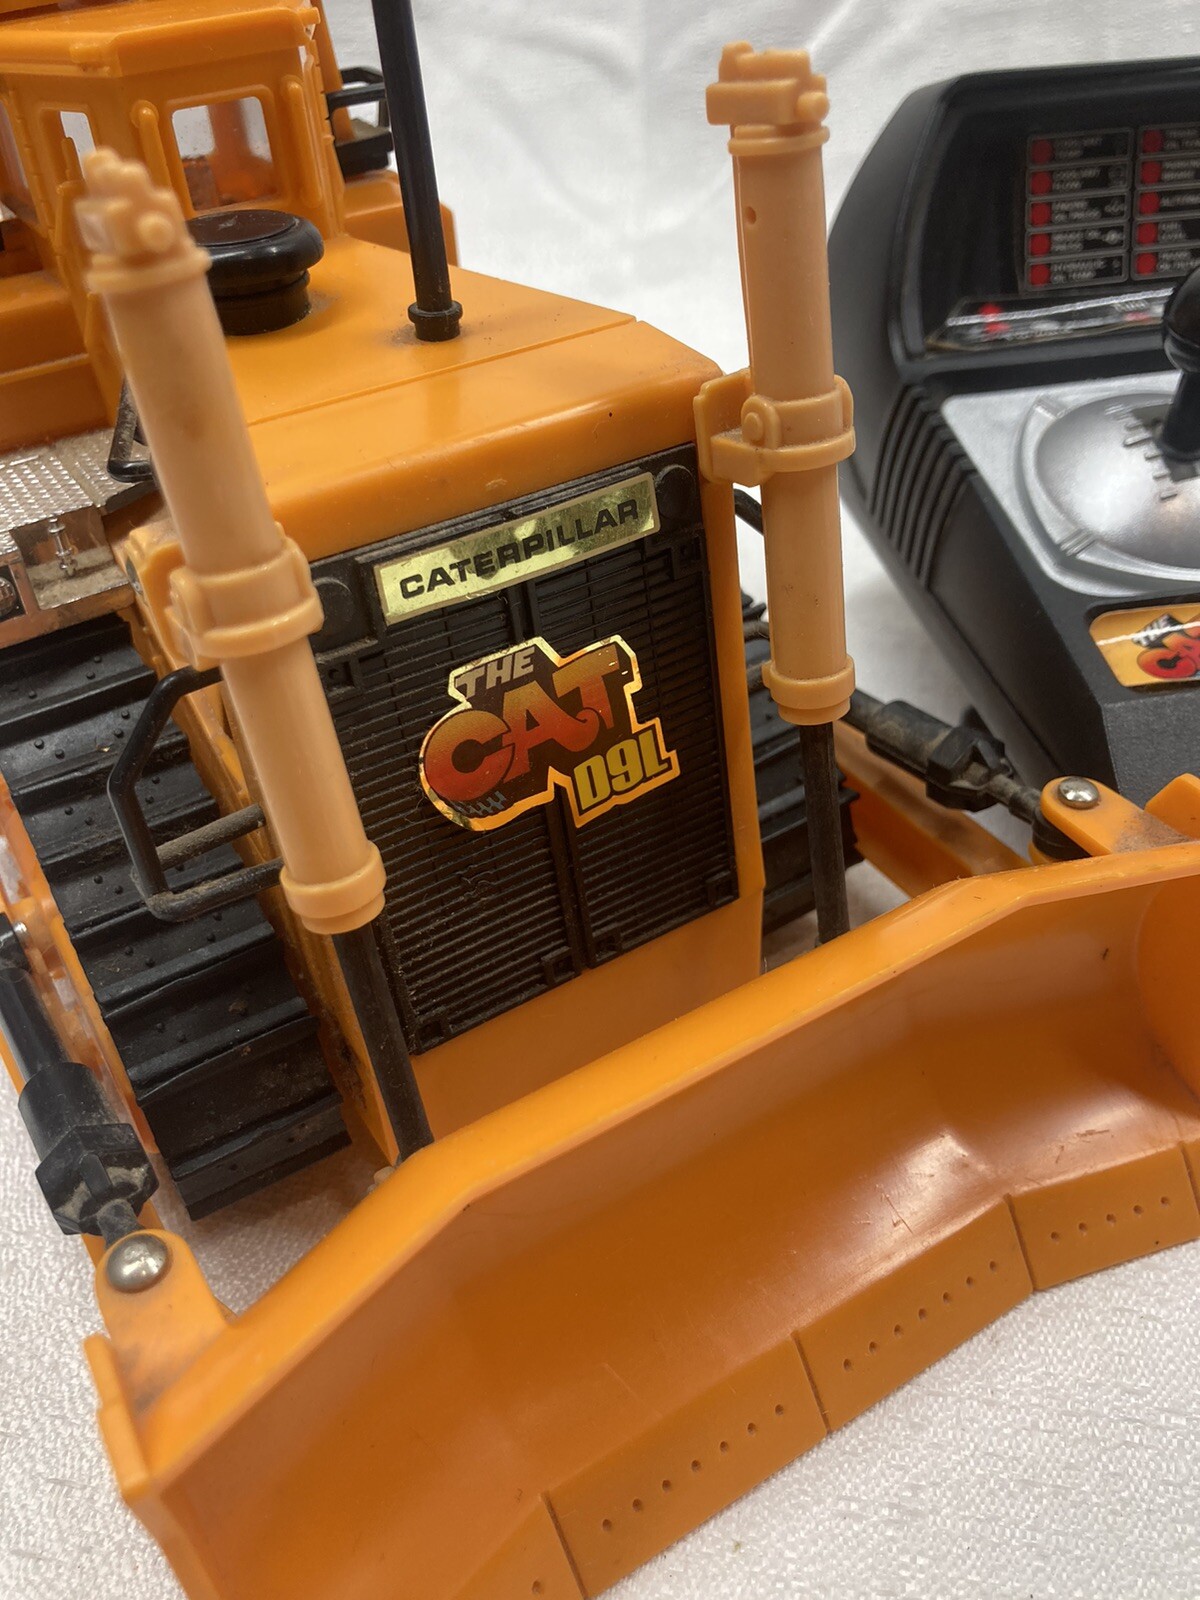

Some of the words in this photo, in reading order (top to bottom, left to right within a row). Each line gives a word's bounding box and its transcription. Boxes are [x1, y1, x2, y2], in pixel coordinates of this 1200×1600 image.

[400, 499, 638, 599] CATERPILLAR
[456, 647, 535, 700] THE
[1136, 618, 1200, 678] CA
[425, 644, 620, 801] CAT
